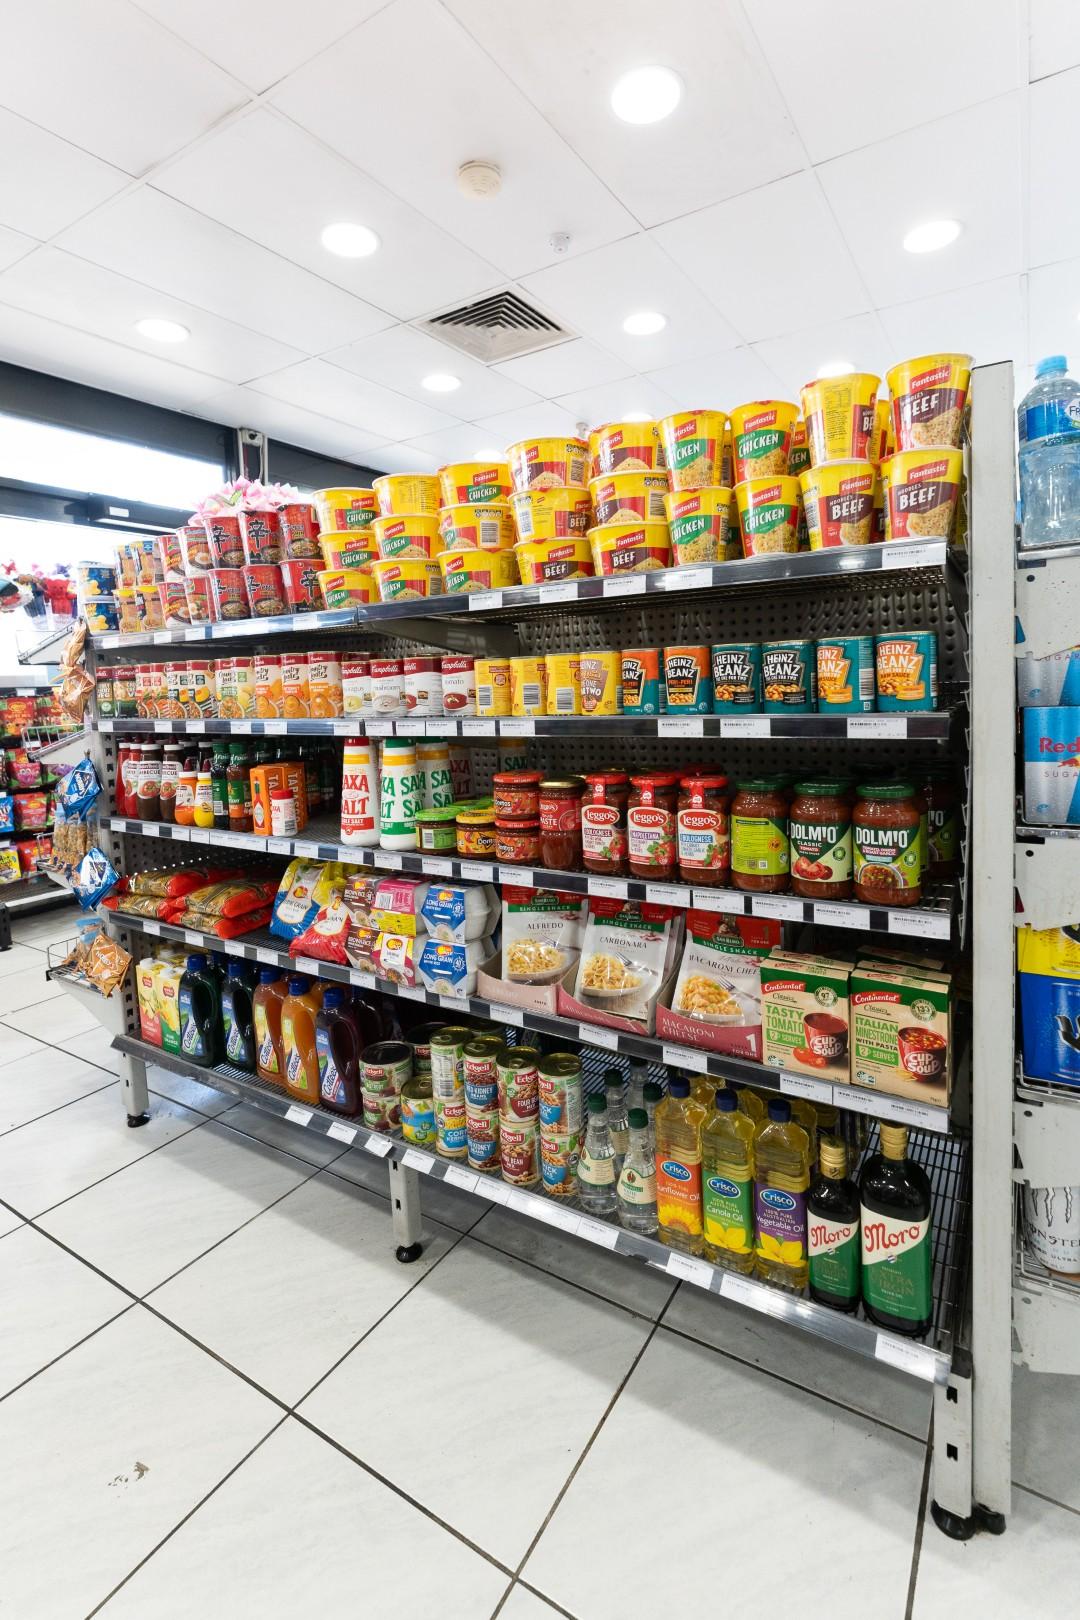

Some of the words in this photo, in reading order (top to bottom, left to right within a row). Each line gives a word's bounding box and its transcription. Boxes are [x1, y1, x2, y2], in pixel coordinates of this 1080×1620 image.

[911, 365, 950, 390] Fantastic
[1069, 405, 1080, 416] FR
[745, 412, 776, 431] Fantastic
[863, 415, 873, 431] BE
[738, 433, 779, 458] CHICKEN
[909, 461, 947, 479] Fantastic
[841, 477, 872, 491] Fantastic
[469, 487, 498, 501] CHICKEN
[899, 485, 937, 510] BEEF
[832, 497, 865, 521] BEEF
[745, 507, 785, 533] CHICKEN
[616, 532, 644, 547] Fantastic
[342, 553, 368, 565] CHICKEN
[613, 552, 636, 568] BEEF
[544, 563, 567, 578] BEEF
[818, 649, 838, 660] EINZ
[879, 644, 912, 656] HEINZ
[623, 661, 639, 671] EINZ
[668, 658, 692, 668] HEINZ
[716, 654, 745, 665] HEINZ
[766, 653, 795, 665] HEINZ
[877, 655, 919, 670] BEANZ
[623, 669, 641, 680] EANZ
[667, 667, 696, 679] BEANZ
[713, 663, 752, 678] BEANZ
[763, 663, 801, 678] BEANZ
[818, 660, 846, 674] EANZ
[1039, 736, 1080, 753] Red
[343, 774, 369, 793] AXA
[342, 797, 369, 815] ALT
[586, 809, 616, 822] Leggo's
[632, 811, 665, 825] Leggo's
[683, 813, 717, 827] Leggo's
[797, 840, 822, 848] CLASSIC
[528, 922, 564, 931] ALFREDO
[602, 919, 627, 929] SINGLE
[599, 936, 648, 951] CARBONARA
[703, 940, 727, 952] SINGLE
[730, 946, 758, 956] SNACK
[764, 982, 804, 992] Continental
[855, 993, 898, 1003] Continental
[765, 1005, 805, 1021] TASTY
[662, 1017, 715, 1039] MACARONI
[766, 1015, 804, 1034] TOMATO
[855, 1016, 898, 1033] ITALIAN
[662, 1026, 698, 1041] CHEESE
[813, 1034, 837, 1045] CUP
[855, 1026, 898, 1045] MINESTRONE
[812, 1041, 843, 1056] SOUP
[855, 1037, 874, 1046] WITH
[875, 1042, 898, 1052] PASTA
[860, 1048, 867, 1056] 2
[872, 1051, 896, 1063] SERVES
[908, 1052, 934, 1063] CUP
[466, 1061, 490, 1072] Edgell
[907, 1060, 941, 1074] SOUP
[516, 1073, 538, 1084] Edge
[517, 1099, 531, 1108] FOUR
[445, 1107, 465, 1116] Edge
[663, 1161, 690, 1178] Crisco
[708, 1177, 740, 1197] Crisco
[689, 1190, 701, 1202] Oil
[761, 1190, 794, 1207] Crisco
[706, 1204, 732, 1218] Canola
[732, 1211, 744, 1223] Oil
[763, 1212, 796, 1225] AUSTRALIAN
[756, 1215, 793, 1231] Vegetable
[793, 1223, 805, 1233] Oil
[810, 1224, 852, 1248] Moro
[864, 1222, 921, 1253] Moro
[1029, 1222, 1080, 1248] ONSTE
